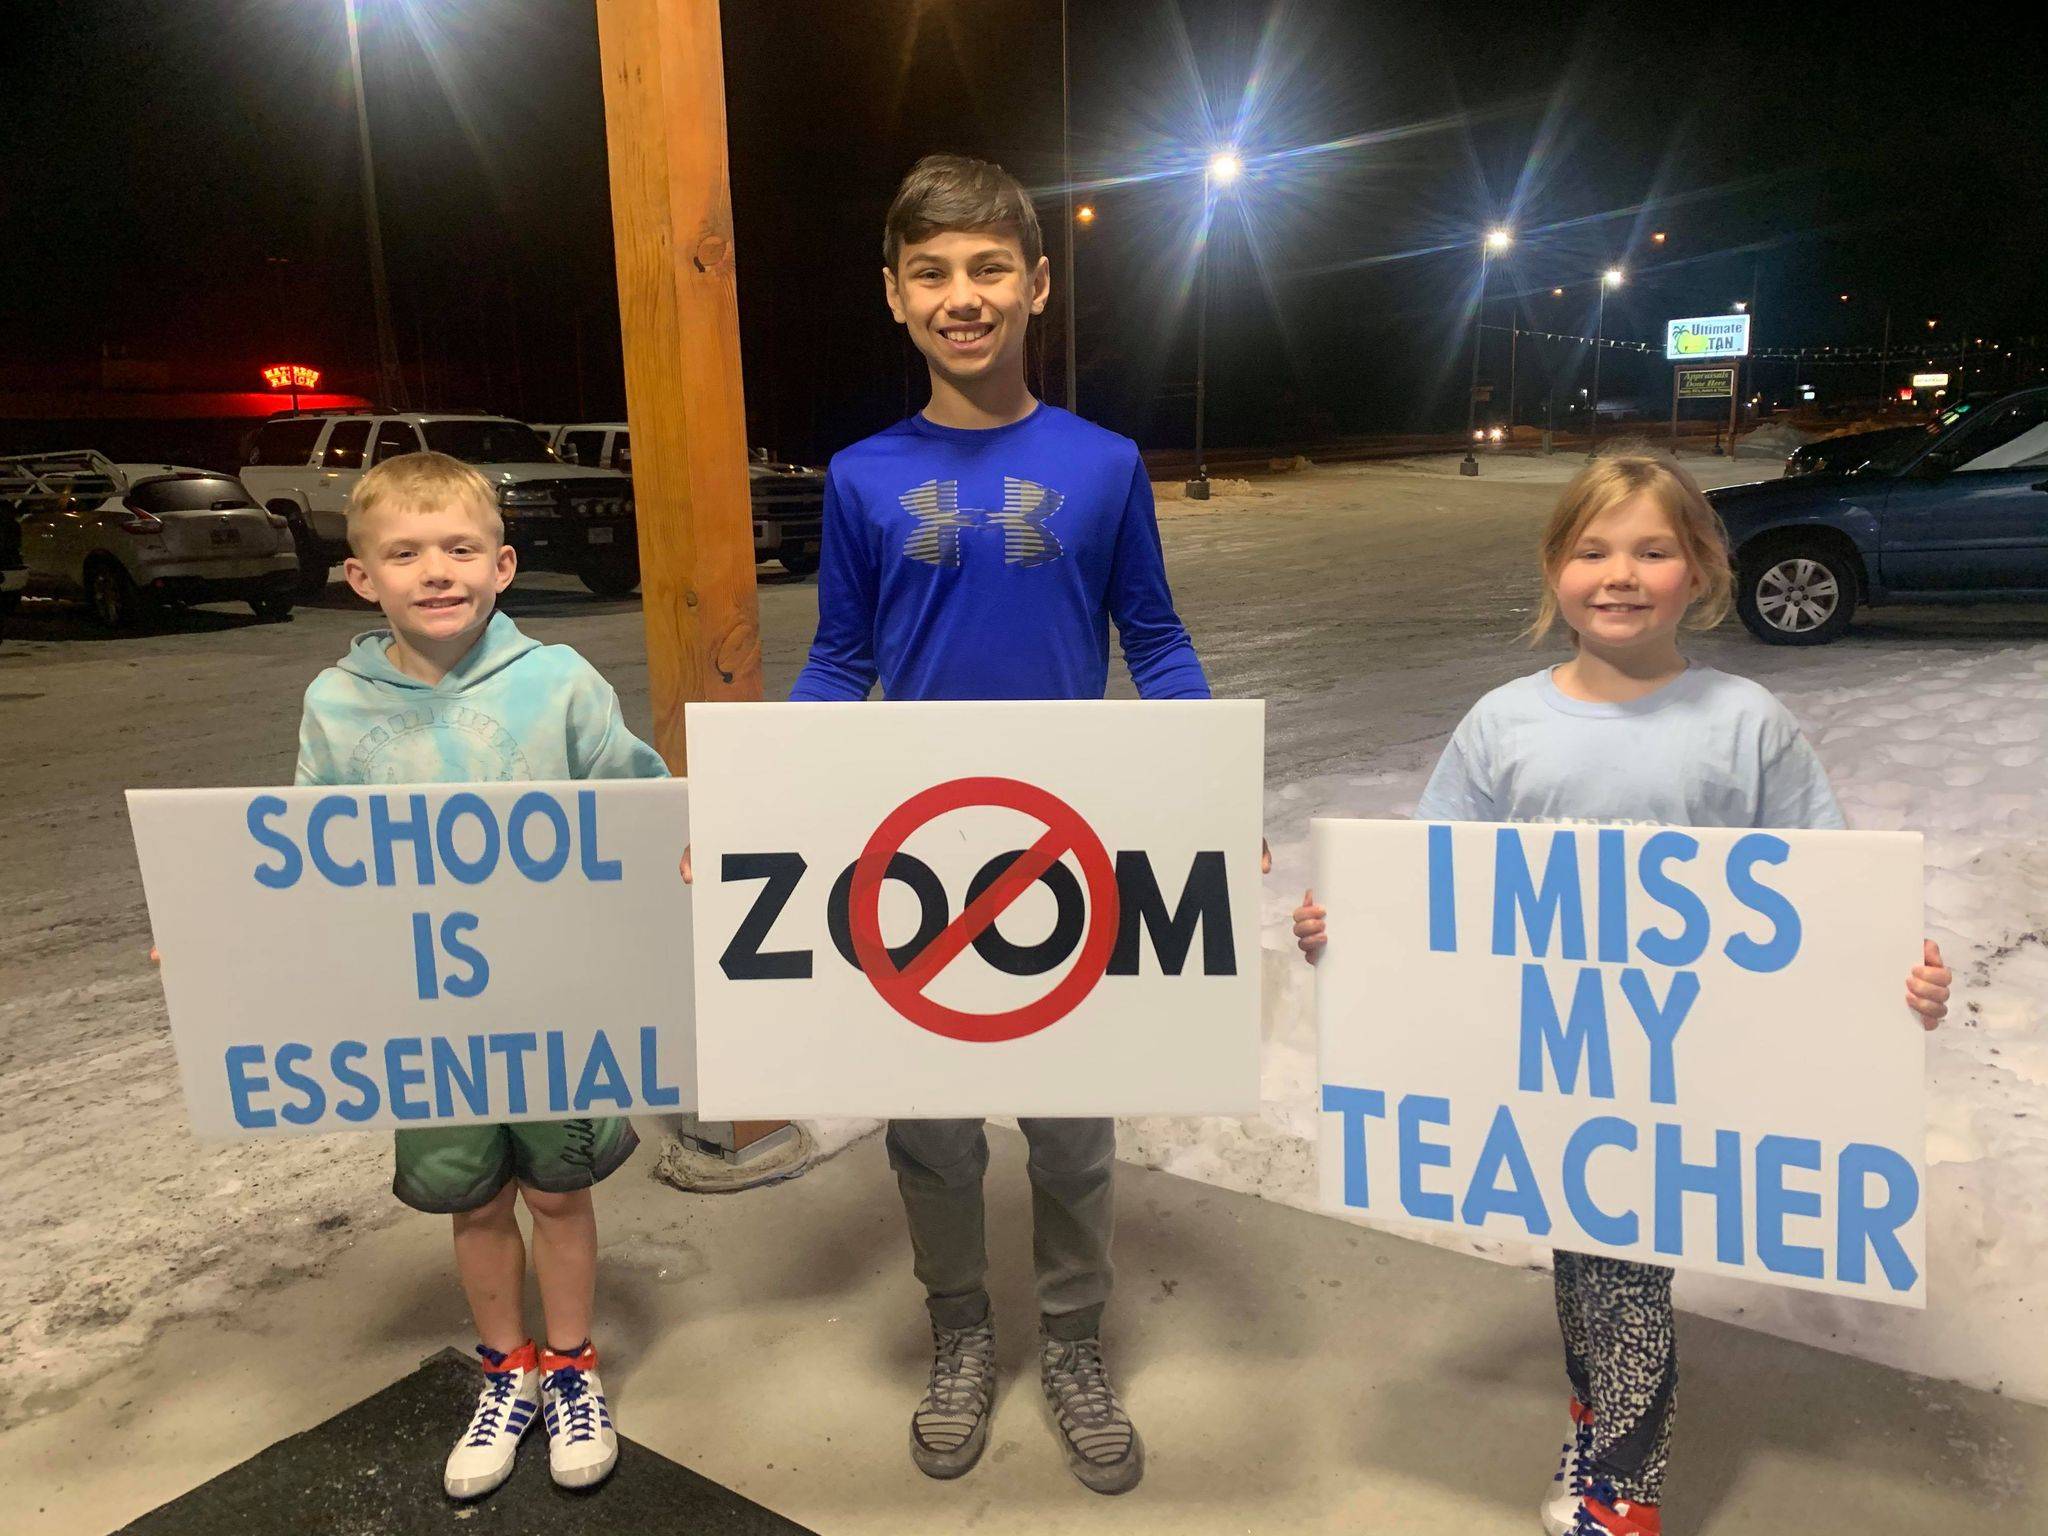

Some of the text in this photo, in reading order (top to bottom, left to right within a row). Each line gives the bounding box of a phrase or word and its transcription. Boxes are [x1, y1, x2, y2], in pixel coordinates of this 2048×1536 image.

[1691, 323, 1742, 336] Ultimate
[1708, 336, 1734, 350] TAN
[247, 791, 621, 888] SCHOOL
[719, 849, 1237, 981] ZOOM
[1428, 825, 1801, 972] I MISS
[412, 912, 489, 999] IS
[226, 1026, 680, 1128] ESSENTIAL
[1519, 964, 1700, 1104] MY
[1322, 1084, 1919, 1291] TEACHER
